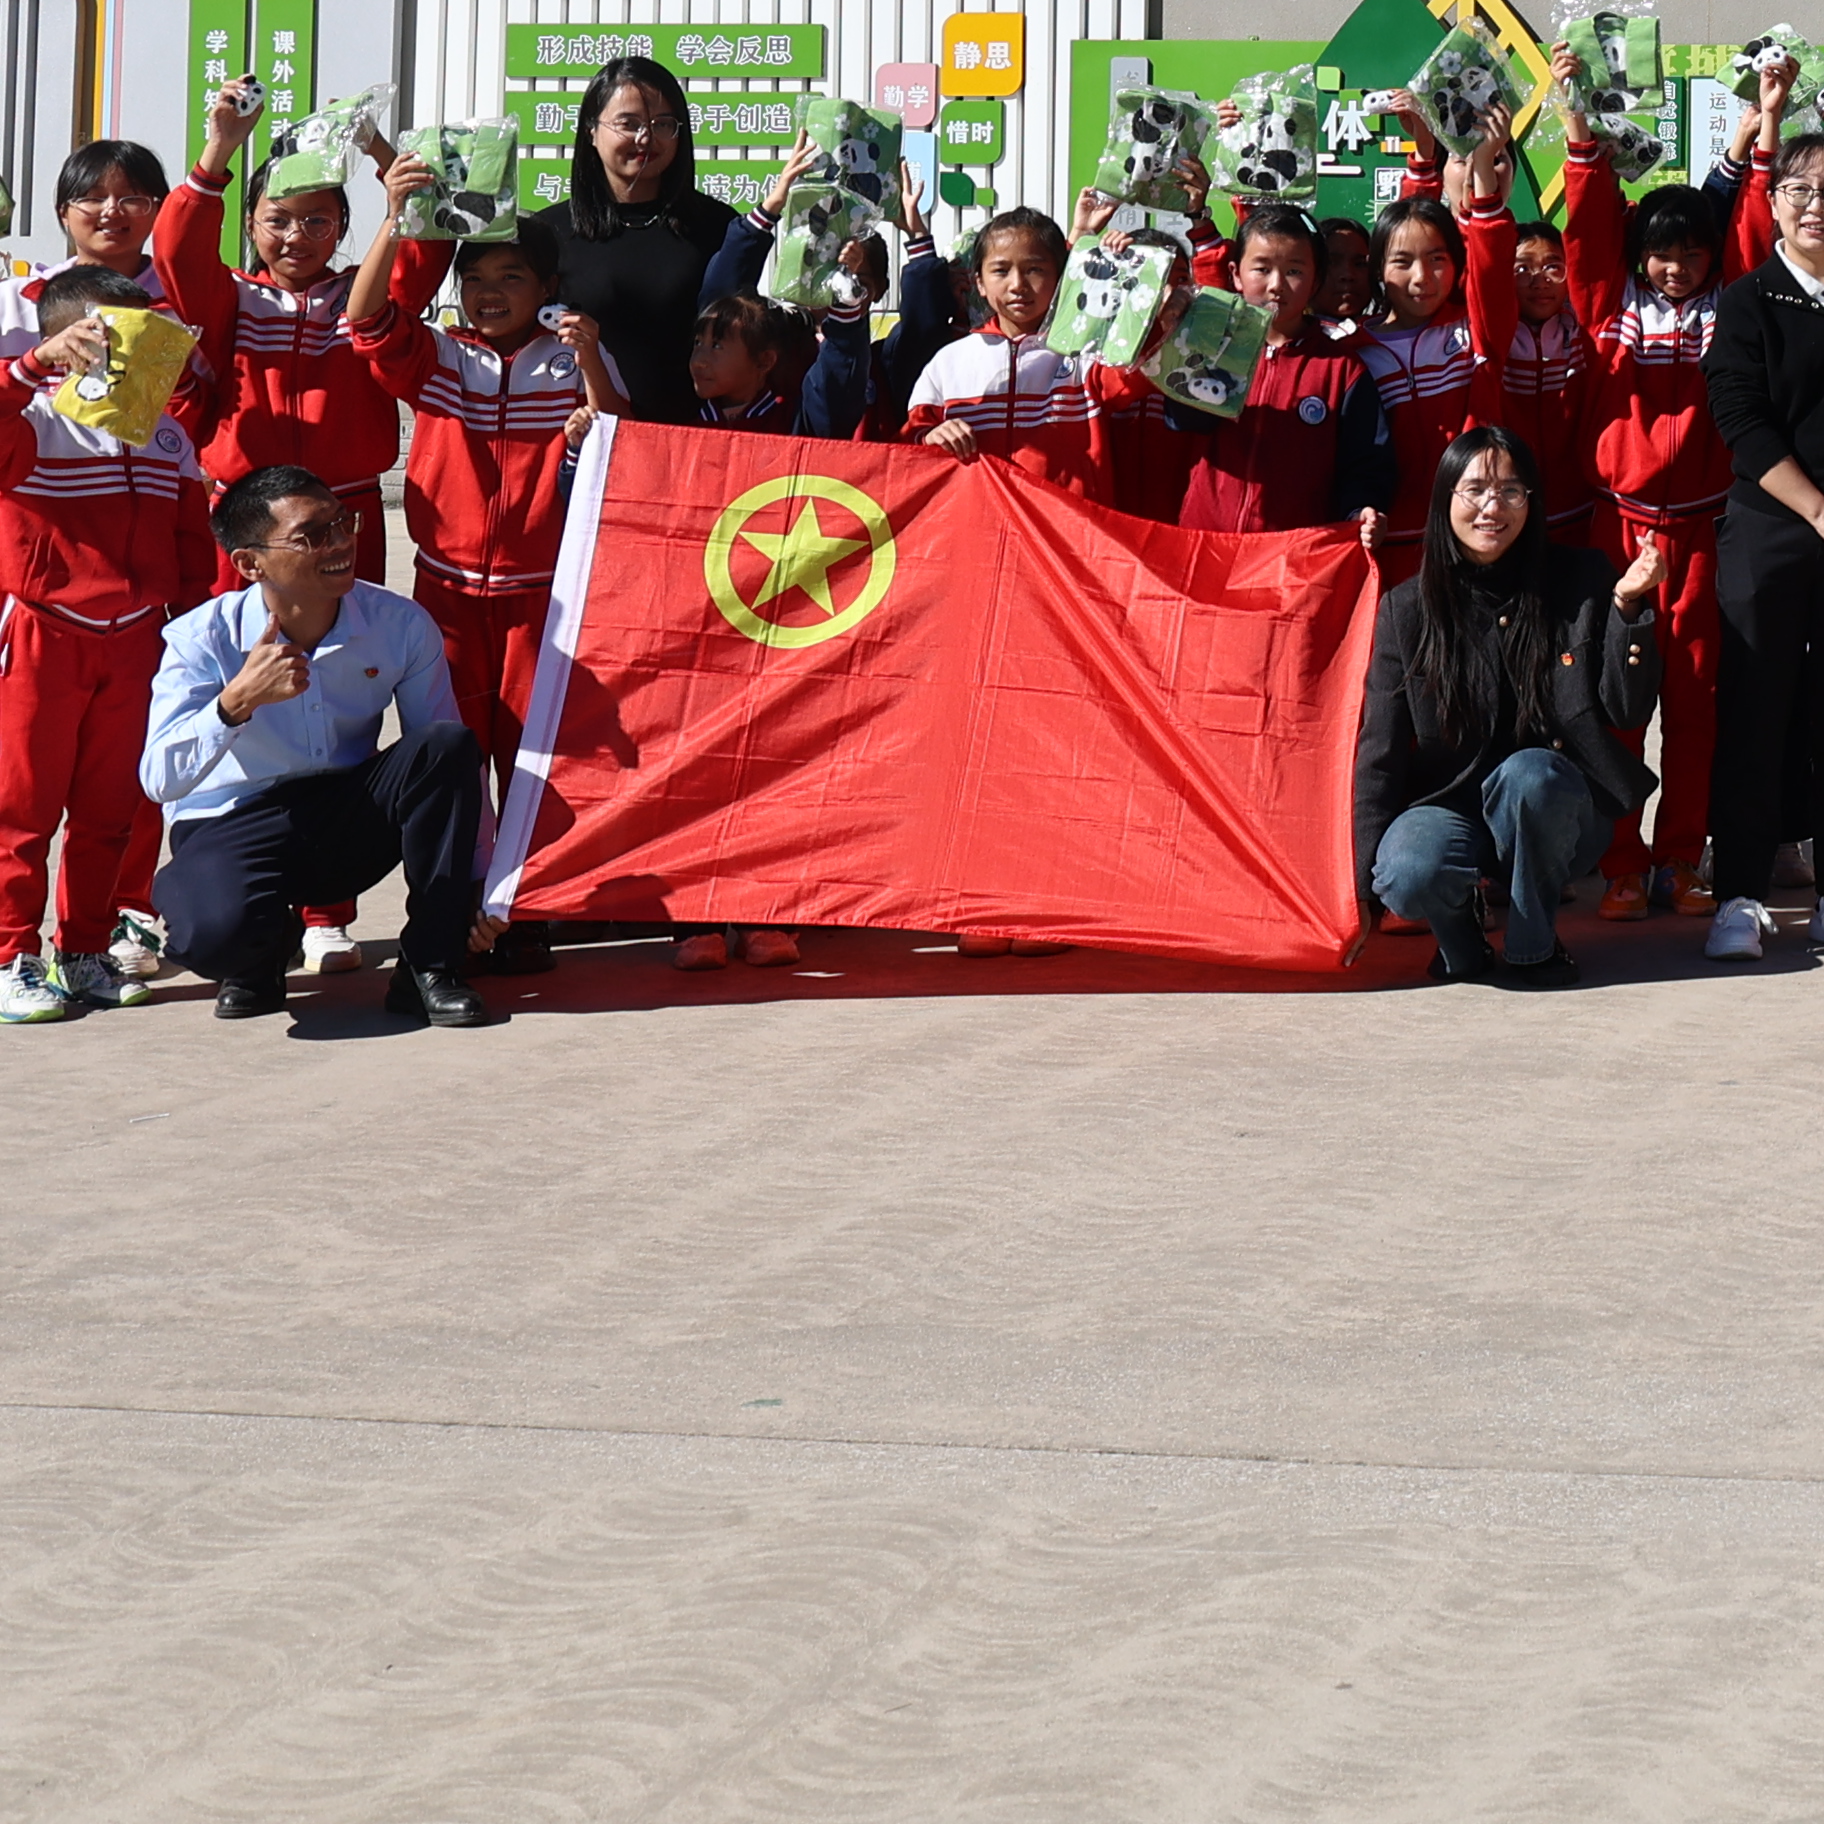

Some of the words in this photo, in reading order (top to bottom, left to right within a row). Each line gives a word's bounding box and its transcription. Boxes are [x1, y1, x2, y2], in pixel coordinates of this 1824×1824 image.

[675, 35, 794, 66] 学会反思
[953, 41, 1012, 70] 静思
[883, 84, 929, 109] 勤学
[946, 120, 994, 145] 惜时
[1321, 100, 1373, 151] 体
